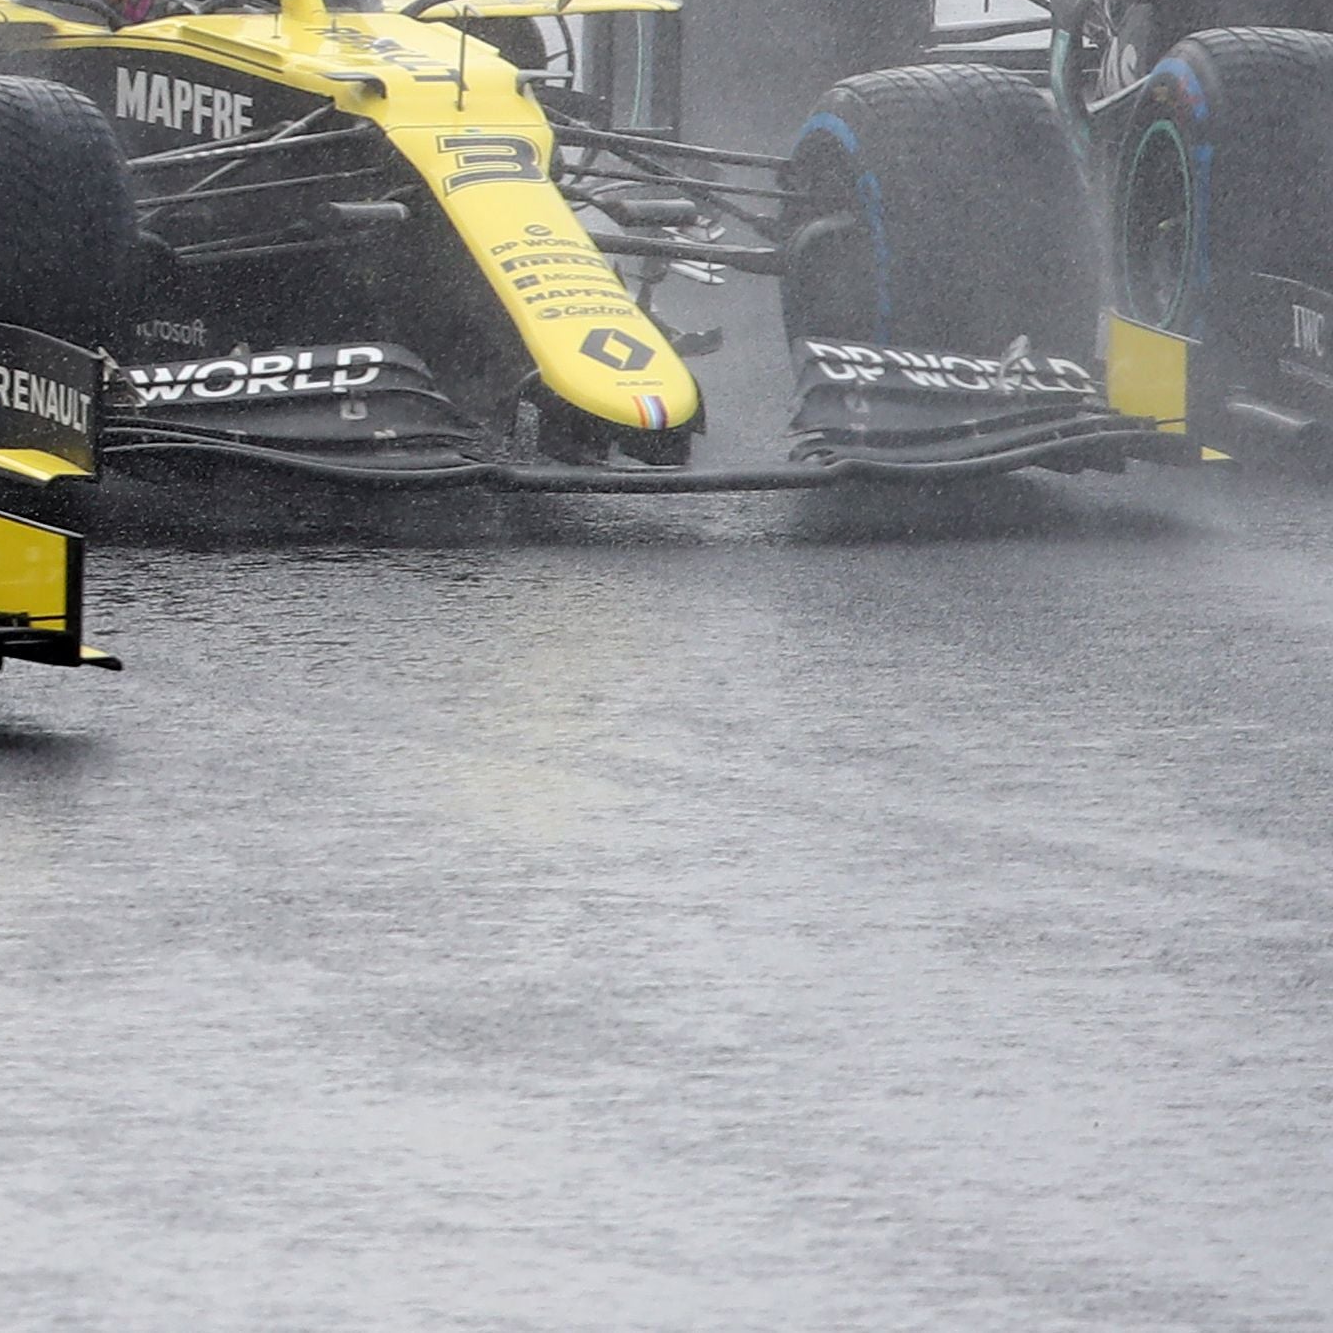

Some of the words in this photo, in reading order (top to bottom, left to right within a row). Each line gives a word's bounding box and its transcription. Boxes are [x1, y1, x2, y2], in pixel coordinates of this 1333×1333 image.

[116, 66, 254, 141] MAPFRE
[436, 133, 549, 197] 3
[136, 318, 207, 347] icrosoft
[129, 344, 385, 407] WORLD
